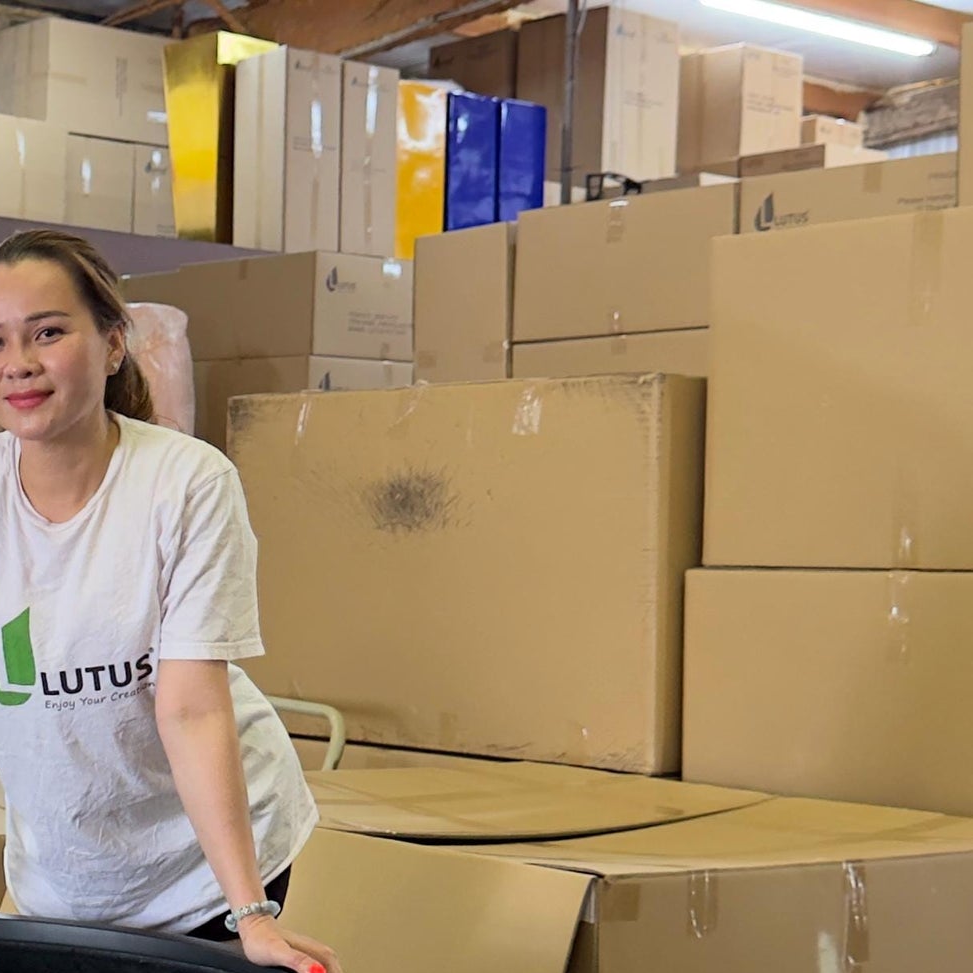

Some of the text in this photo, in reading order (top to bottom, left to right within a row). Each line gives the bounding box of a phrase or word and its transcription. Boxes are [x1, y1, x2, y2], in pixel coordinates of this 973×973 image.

[40, 653, 153, 696] LUTUS
[45, 700, 76, 711] Enjoy
[79, 695, 107, 706] Your
